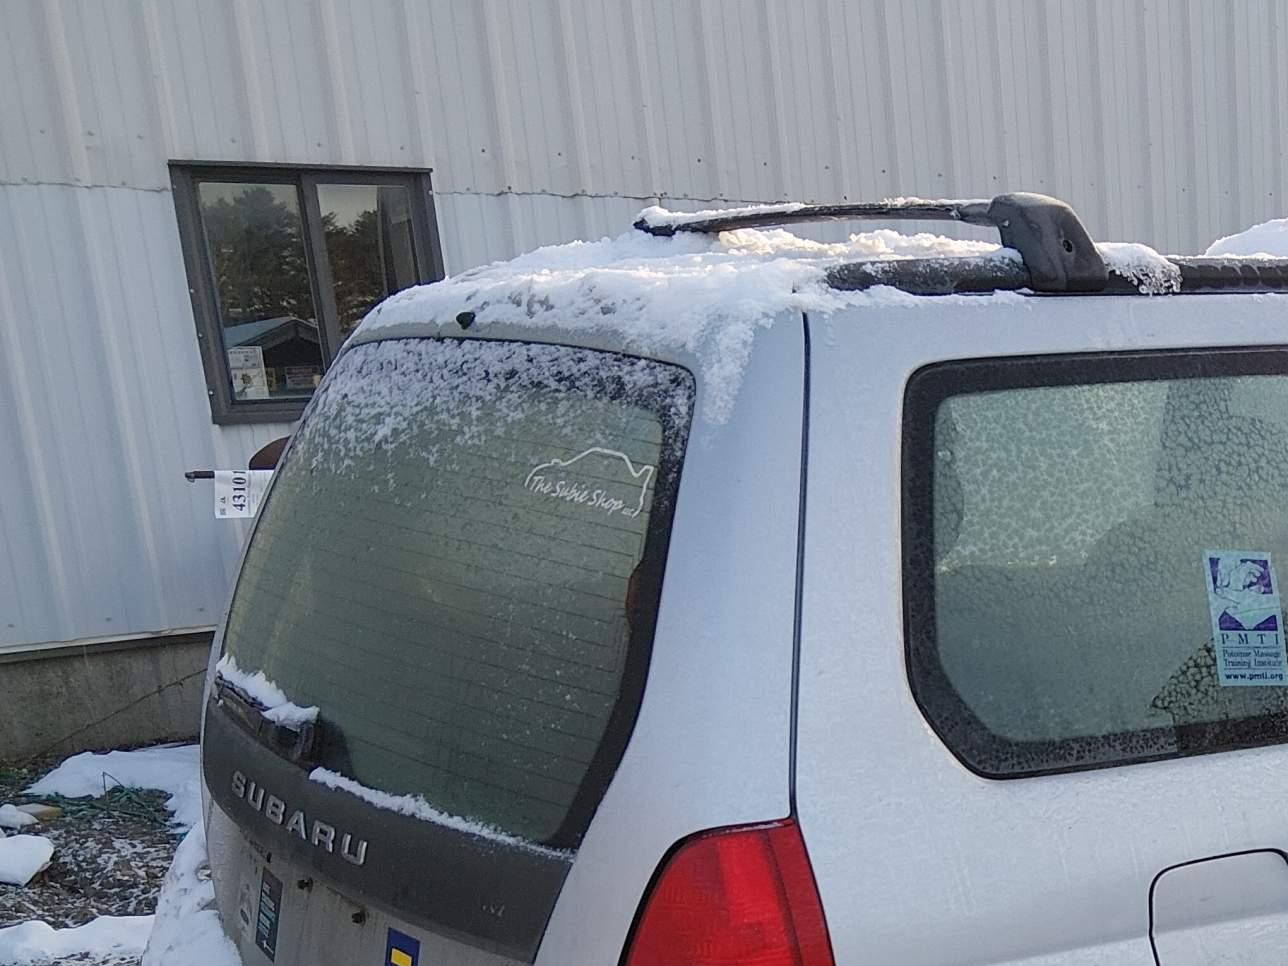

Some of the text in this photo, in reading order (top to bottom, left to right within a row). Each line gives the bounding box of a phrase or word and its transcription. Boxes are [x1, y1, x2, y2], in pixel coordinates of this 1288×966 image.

[530, 476, 553, 494] The
[551, 481, 590, 503] Subie
[587, 490, 626, 516] Shop
[231, 770, 369, 866] SUBARU
